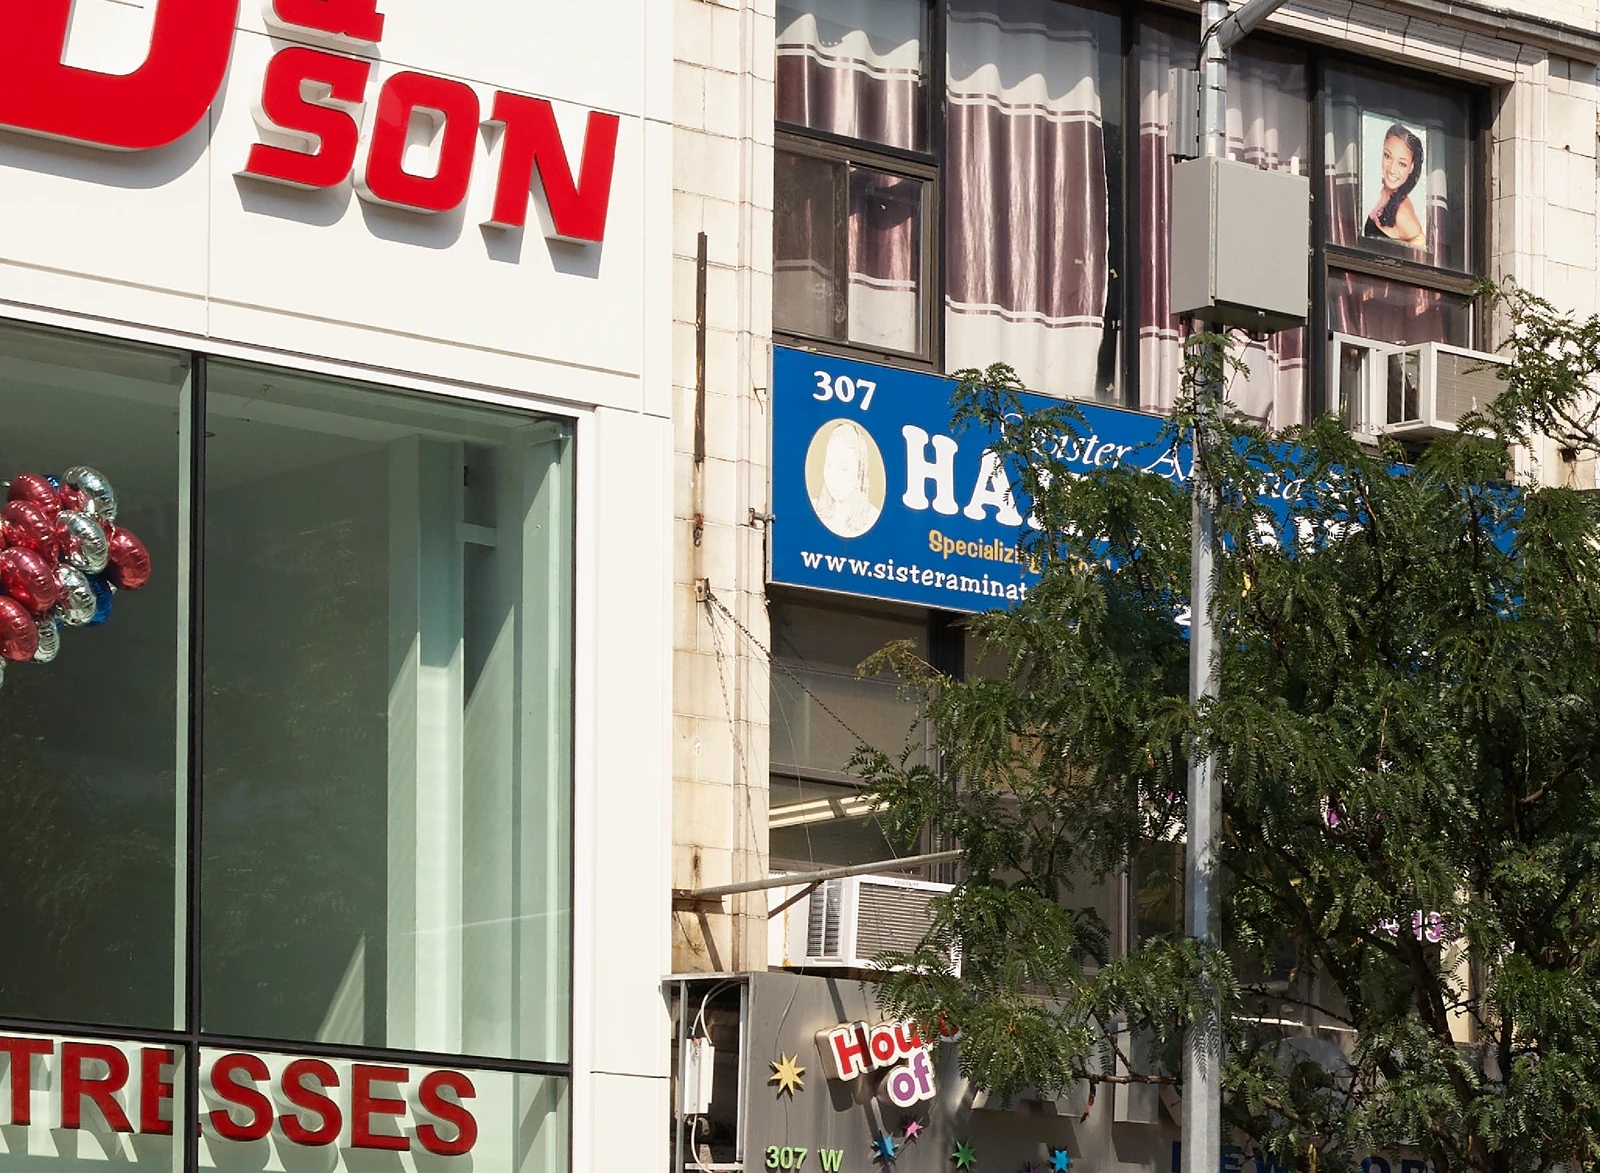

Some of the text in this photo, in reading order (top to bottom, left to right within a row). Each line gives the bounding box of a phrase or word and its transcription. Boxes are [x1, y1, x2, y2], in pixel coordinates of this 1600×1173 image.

[245, 46, 621, 244] SON
[812, 370, 877, 411] 307
[800, 550, 1036, 602] www.sisteraminat
[892, 1051, 931, 1102] of
[765, 1145, 844, 1173] 307 W
